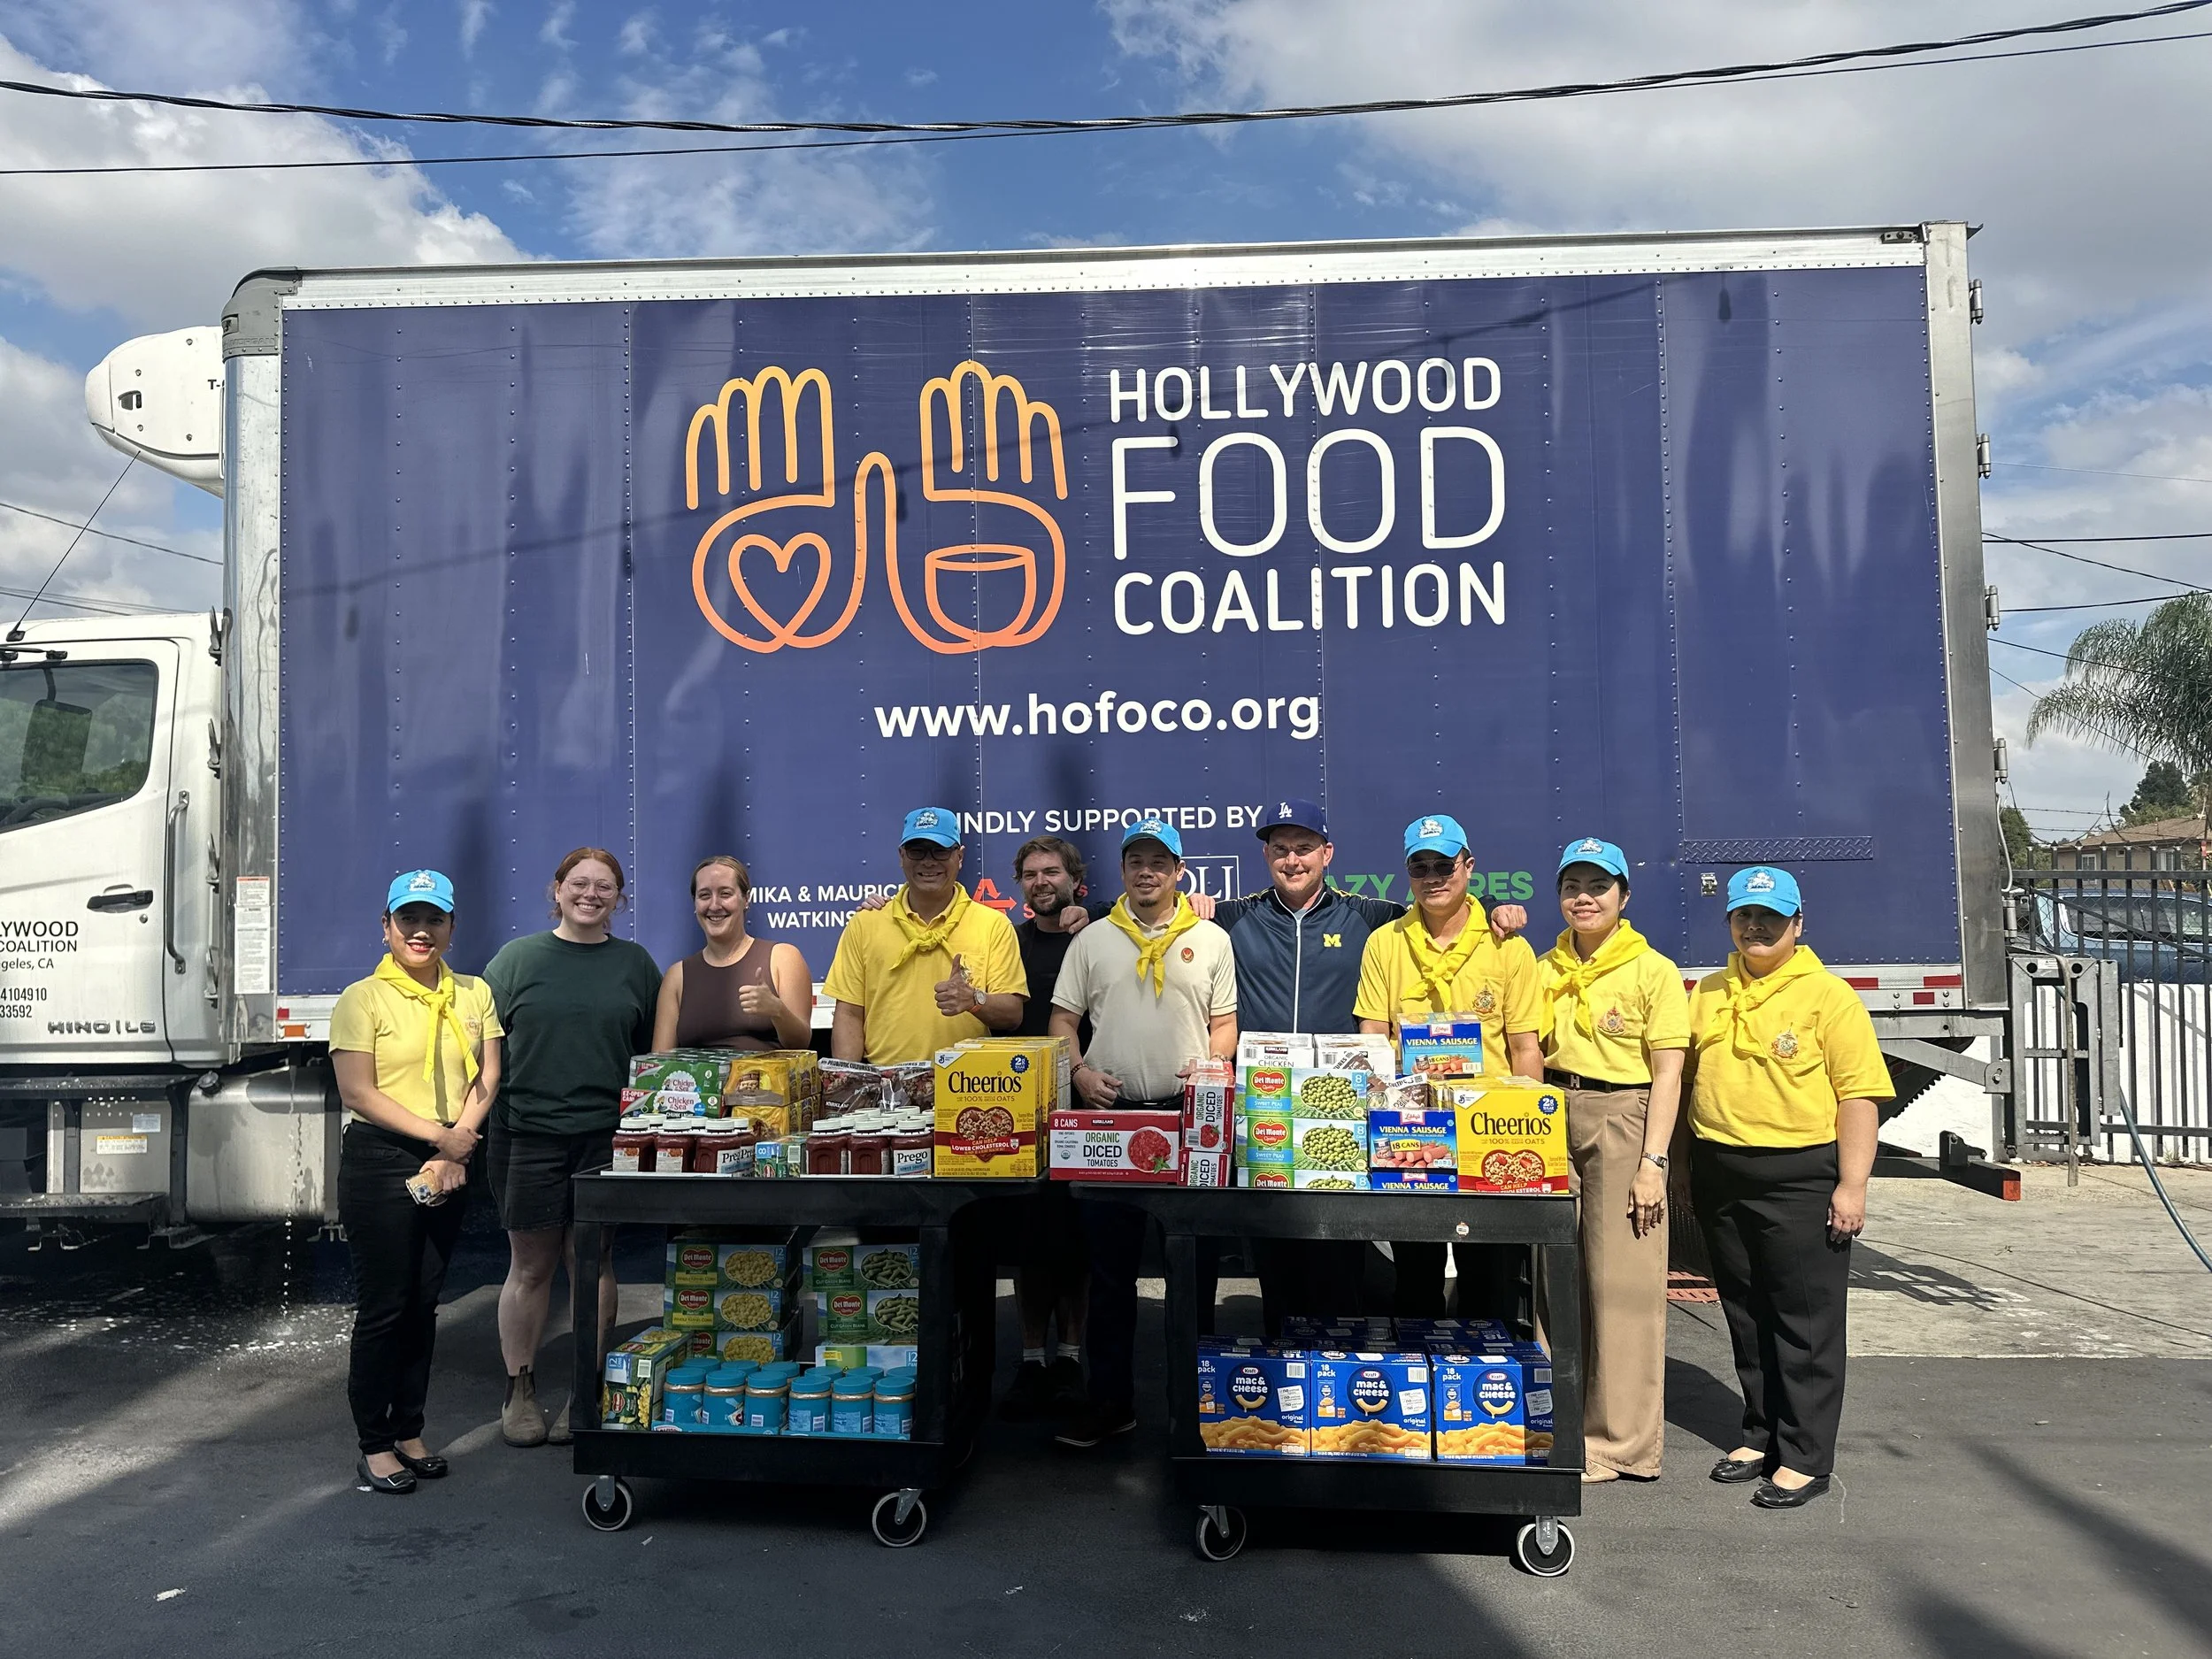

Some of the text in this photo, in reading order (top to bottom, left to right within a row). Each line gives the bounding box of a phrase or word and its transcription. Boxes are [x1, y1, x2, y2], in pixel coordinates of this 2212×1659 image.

[1110, 357, 1502, 423] HOLLYWOOD
[1111, 426, 1505, 560] FOOD
[1114, 561, 1505, 635] COALITION
[873, 690, 1319, 740] www.hofoco.org
[956, 805, 1263, 834] INDLY SUPPORTED BY
[797, 885, 811, 902] &
[818, 883, 906, 902] MAURIC
[767, 910, 856, 929] WATKINS
[0, 921, 79, 937] YWOOD
[1324, 933, 1341, 948] M
[0, 957, 54, 972] geles, CA
[0, 987, 47, 1002] 4104910
[0, 1004, 32, 1018] 33592
[48, 1020, 111, 1034] HINO
[1440, 1037, 1479, 1046] SAUSAGE
[948, 1071, 1022, 1094] Cheerios
[1254, 1076, 1285, 1085] Del Monte
[1355, 1074, 1363, 1083] 8
[1205, 1091, 1217, 1123] DICED
[1054, 1118, 1078, 1128] 8 CANS
[1379, 1125, 1447, 1134] VIENNA SAUSAGE
[1470, 1111, 1552, 1135] Cheerios
[1266, 1128, 1286, 1137] Monte
[1356, 1125, 1364, 1135] 8
[1085, 1132, 1120, 1143] ORGANIC
[897, 1150, 928, 1164] Prego
[1083, 1145, 1122, 1158] DICED
[1087, 1158, 1118, 1168] TOMATOES
[1200, 1158, 1210, 1187] DICED
[1267, 1179, 1287, 1188] Monte
[1359, 1177, 1366, 1187] 8
[775, 1248, 784, 1256] 12
[609, 1357, 618, 1367] 12
[908, 1352, 918, 1362] 12
[1317, 1370, 1336, 1379] pack
[1257, 1377, 1266, 1386] &
[1356, 1380, 1386, 1389] mac &
[1481, 1382, 1513, 1391] mac &
